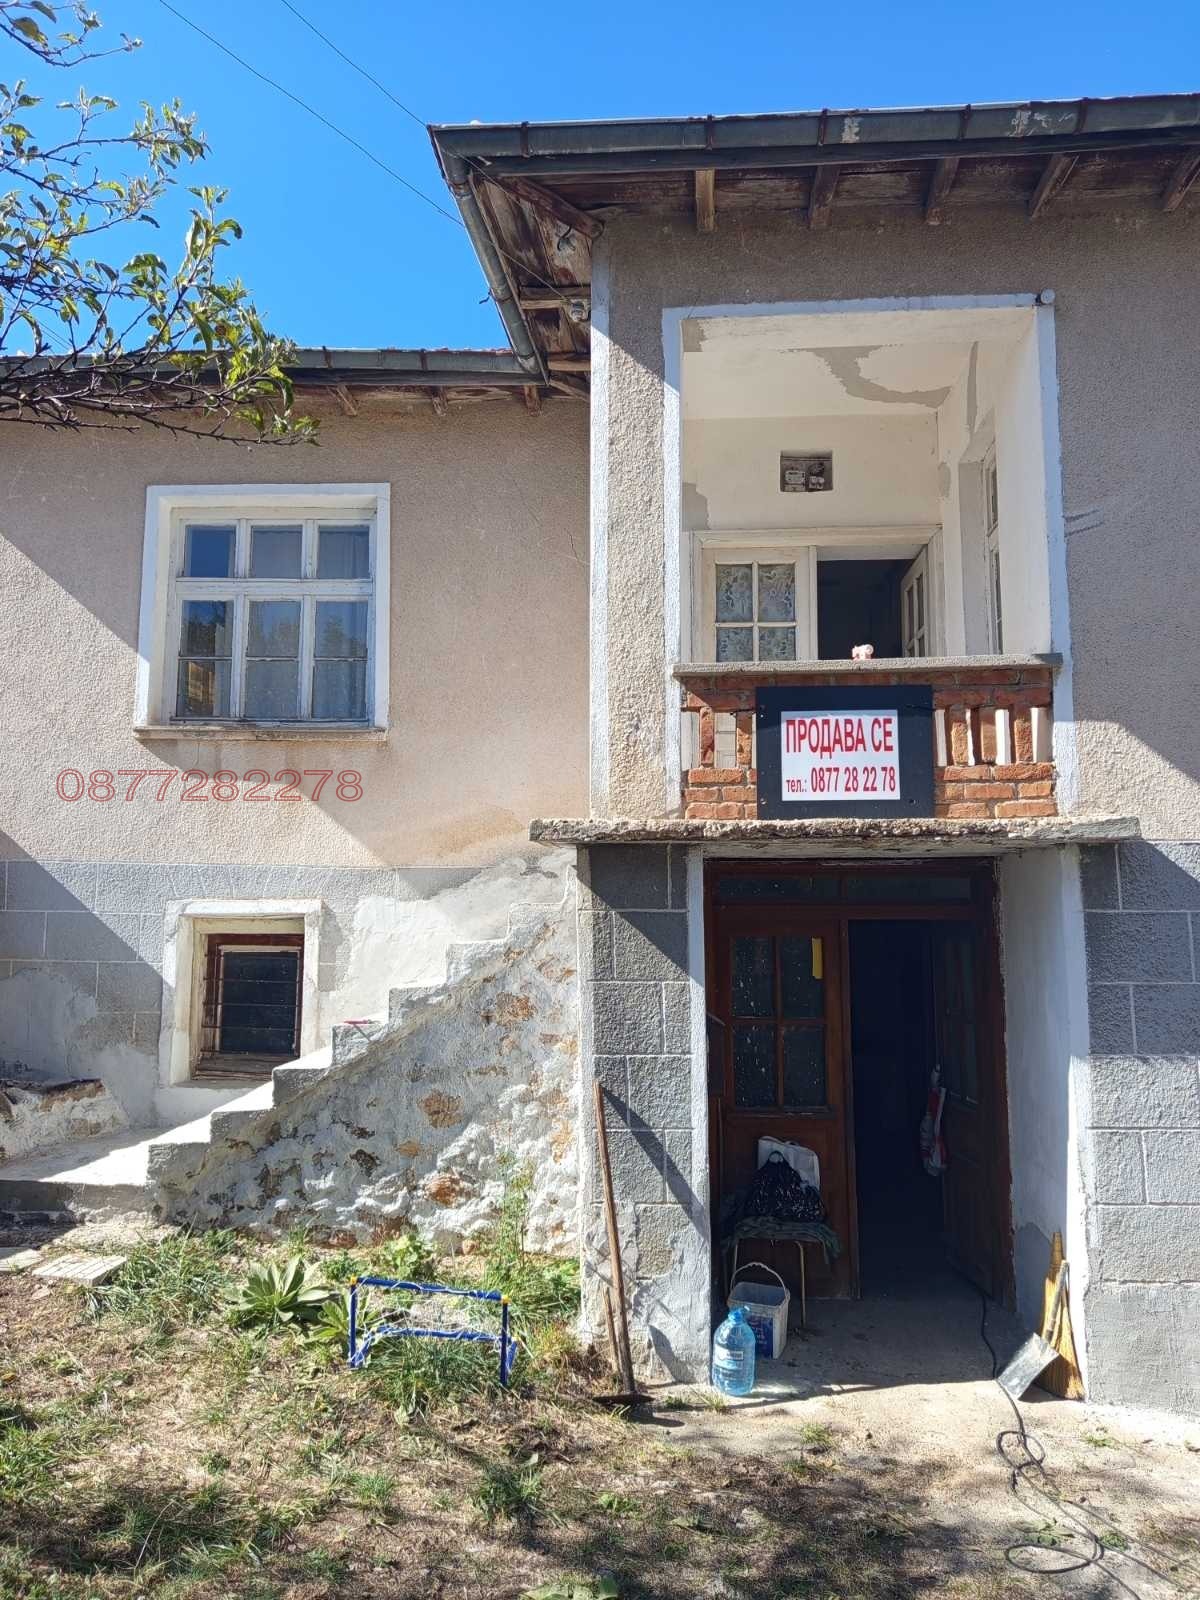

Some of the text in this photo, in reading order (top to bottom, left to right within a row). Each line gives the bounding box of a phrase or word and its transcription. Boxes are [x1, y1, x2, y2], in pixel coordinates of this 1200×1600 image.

[786, 718, 894, 759] ПРОДАВА СЕ
[786, 766, 896, 793] тел.: 0877 28 22 78
